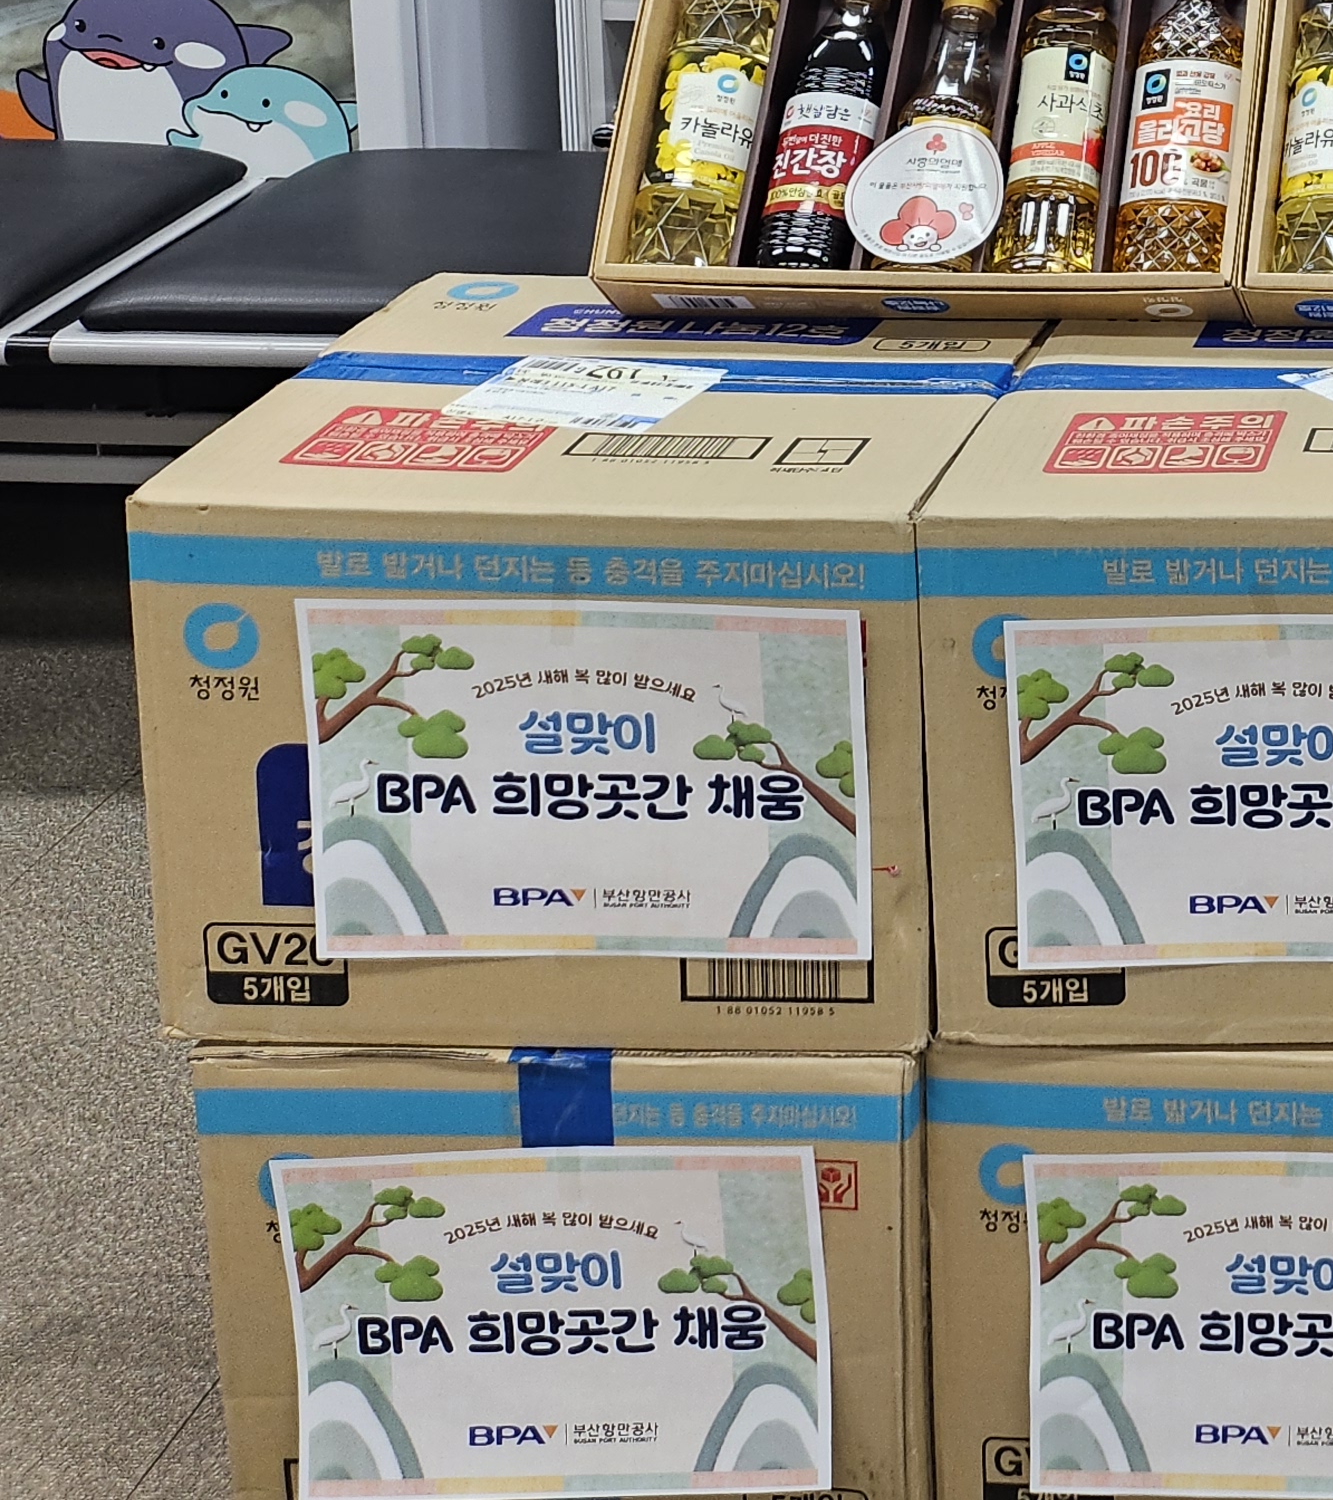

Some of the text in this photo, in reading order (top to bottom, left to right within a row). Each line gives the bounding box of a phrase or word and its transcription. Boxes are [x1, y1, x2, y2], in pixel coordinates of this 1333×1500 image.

[680, 115, 754, 150] 카놀라유
[772, 147, 847, 179] 진간장
[1123, 414, 1277, 432] 파손주의
[1102, 557, 1155, 586] 발로
[1255, 557, 1332, 586] 던지는
[188, 674, 261, 702] 청정원
[471, 669, 696, 703] 2025년 새해 복 많이 받으세요
[518, 709, 657, 756] 설맞이
[376, 771, 804, 822] BPA 희망곳간 채움
[1076, 787, 1175, 827] BPA
[493, 888, 574, 907] BPA
[602, 889, 691, 903] 부산항만공사
[1021, 977, 1090, 1005] 5개입
